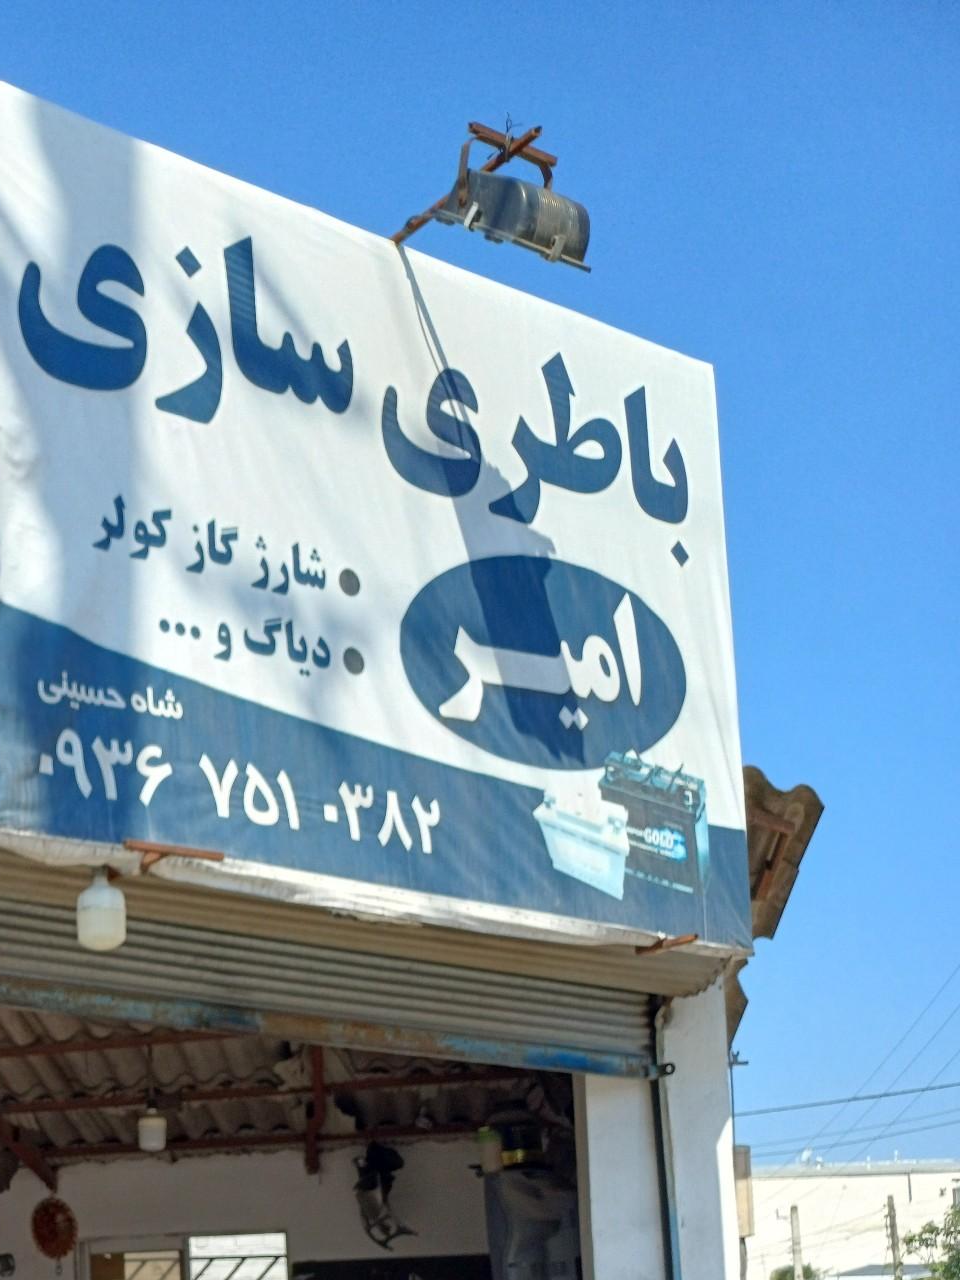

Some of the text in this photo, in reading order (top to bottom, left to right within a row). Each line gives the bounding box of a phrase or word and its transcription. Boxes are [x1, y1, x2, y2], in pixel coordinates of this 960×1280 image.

[18, 235, 690, 567] باطری سازی
[92, 493, 327, 596] شارژ گاز کولر
[213, 622, 232, 662] و
[243, 617, 331, 677] دیاگ
[438, 591, 642, 731] امیر
[37, 669, 184, 720] شاه حسینی
[39, 728, 440, 855] ۰۹۳۶ ۷۵۱ ۰۳۸۲
